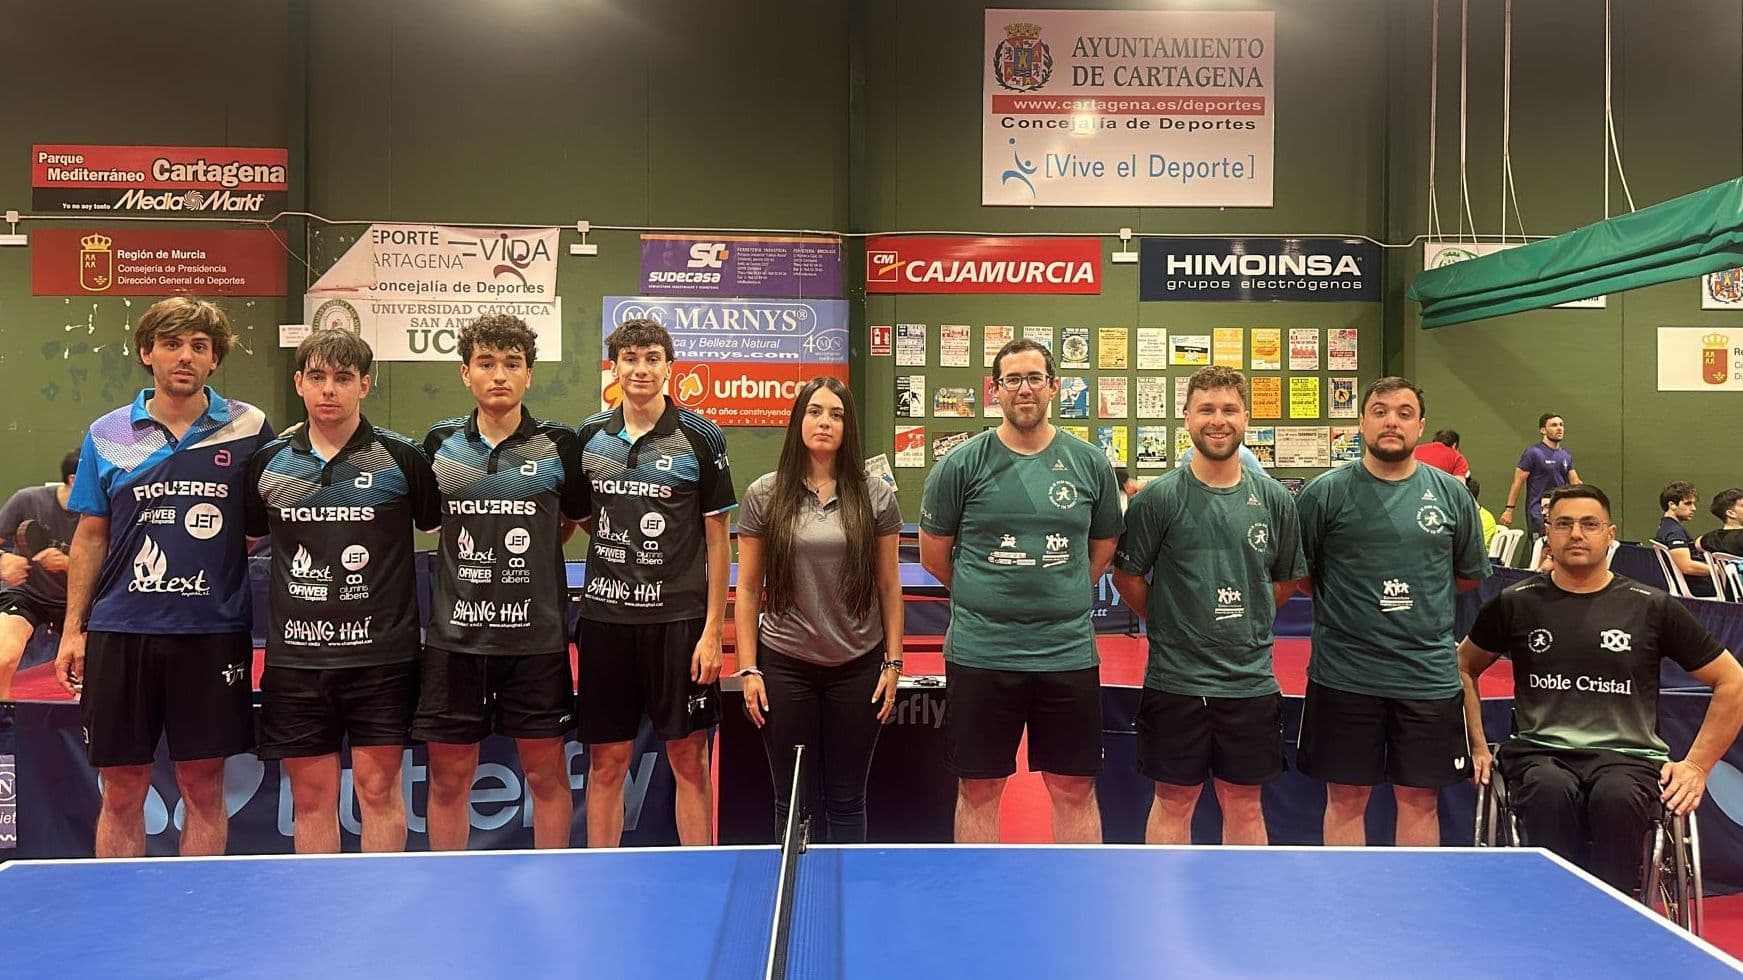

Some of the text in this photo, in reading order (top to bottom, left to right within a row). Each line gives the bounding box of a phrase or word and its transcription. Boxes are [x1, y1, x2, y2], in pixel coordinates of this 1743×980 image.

[1071, 36, 1264, 59] AYUNTAMIENTO
[1072, 66, 1264, 88] DE CARTAGENA
[1013, 99, 1262, 112] www.cartagena.es/deportes
[1001, 117, 1256, 136] Concejalía de Deportes
[38, 152, 84, 165] Parque
[1116, 154, 1136, 178] el
[47, 158, 286, 187] Mediterráneo Cartagena
[113, 189, 264, 212] Media Markt
[117, 249, 206, 261] Región de Murcia
[873, 254, 894, 263] CM
[117, 264, 226, 276] Consejería de Presidencia
[905, 261, 1095, 283] CAJAMURCIA
[1167, 255, 1361, 276] HIMOINSA
[117, 275, 246, 288] Dirección General de Deportes
[453, 281, 471, 293] de
[476, 282, 544, 296] Deportes
[1167, 279, 1362, 290] grupos electrógenos
[371, 304, 473, 315] UNIVERSIDAD
[410, 318, 440, 328] SAN
[690, 341, 695, 350] y
[699, 338, 738, 349] Belleza
[741, 339, 781, 349] Natural
[719, 407, 738, 416] años
[740, 409, 791, 417] construyendo
[132, 480, 230, 501] FIGUERES
[591, 480, 672, 498] FIGUERES
[280, 506, 375, 522] FIGUERES
[448, 500, 537, 516] FIGUERES
[284, 618, 335, 641] SHANG
[1529, 674, 1632, 695] Doble Cristal
